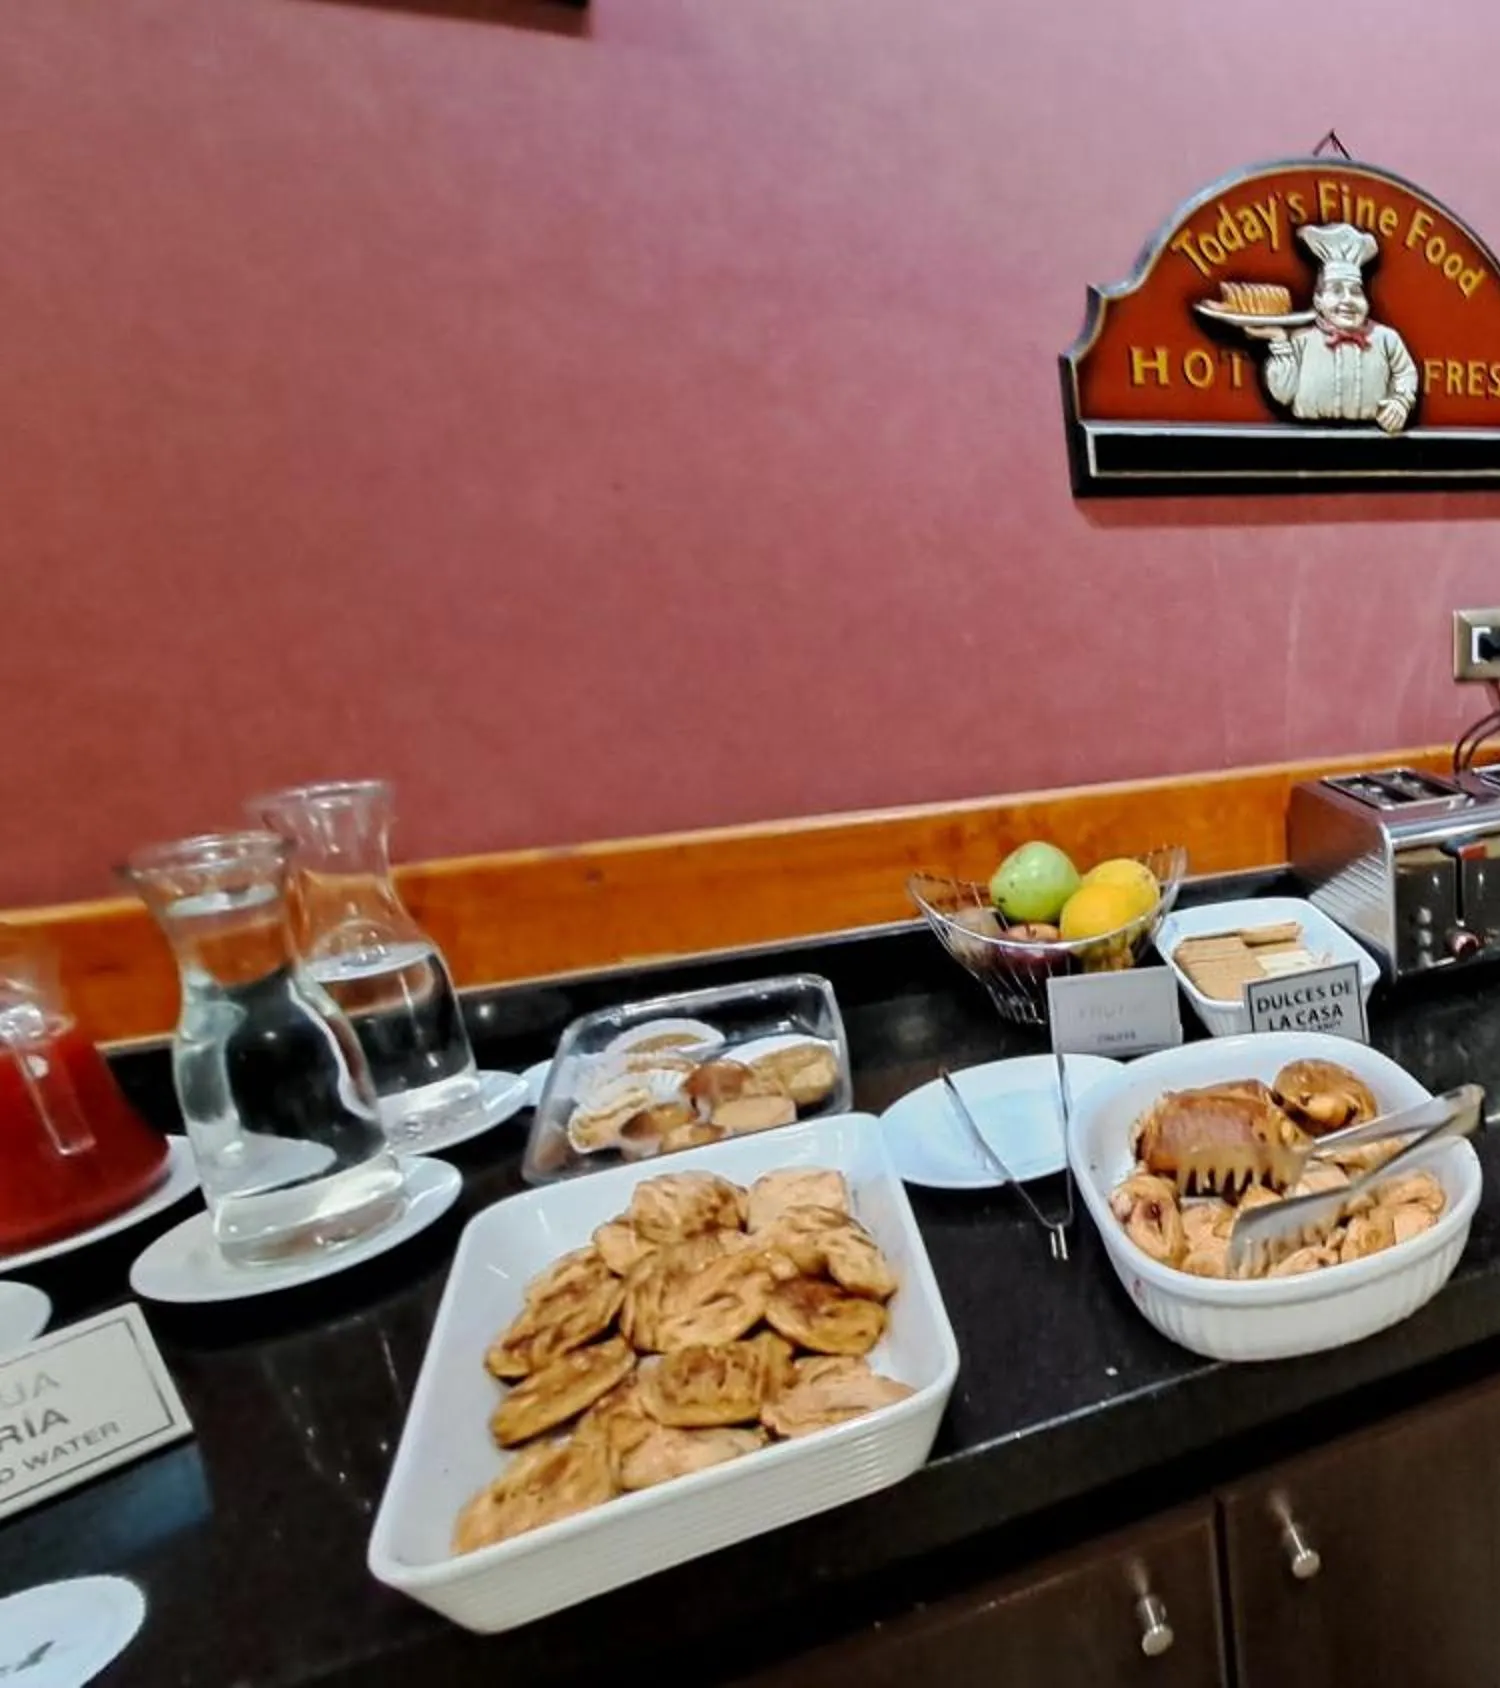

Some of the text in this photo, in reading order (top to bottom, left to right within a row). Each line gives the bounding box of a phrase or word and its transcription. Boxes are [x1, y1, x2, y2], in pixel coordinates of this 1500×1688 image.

[1170, 179, 1488, 299] Today's Fine Food
[1130, 345, 1246, 389] HOT
[1257, 986, 1326, 1014] DULCES
[1269, 1003, 1344, 1032] LA CASA
[22, 1421, 121, 1471] WATER
